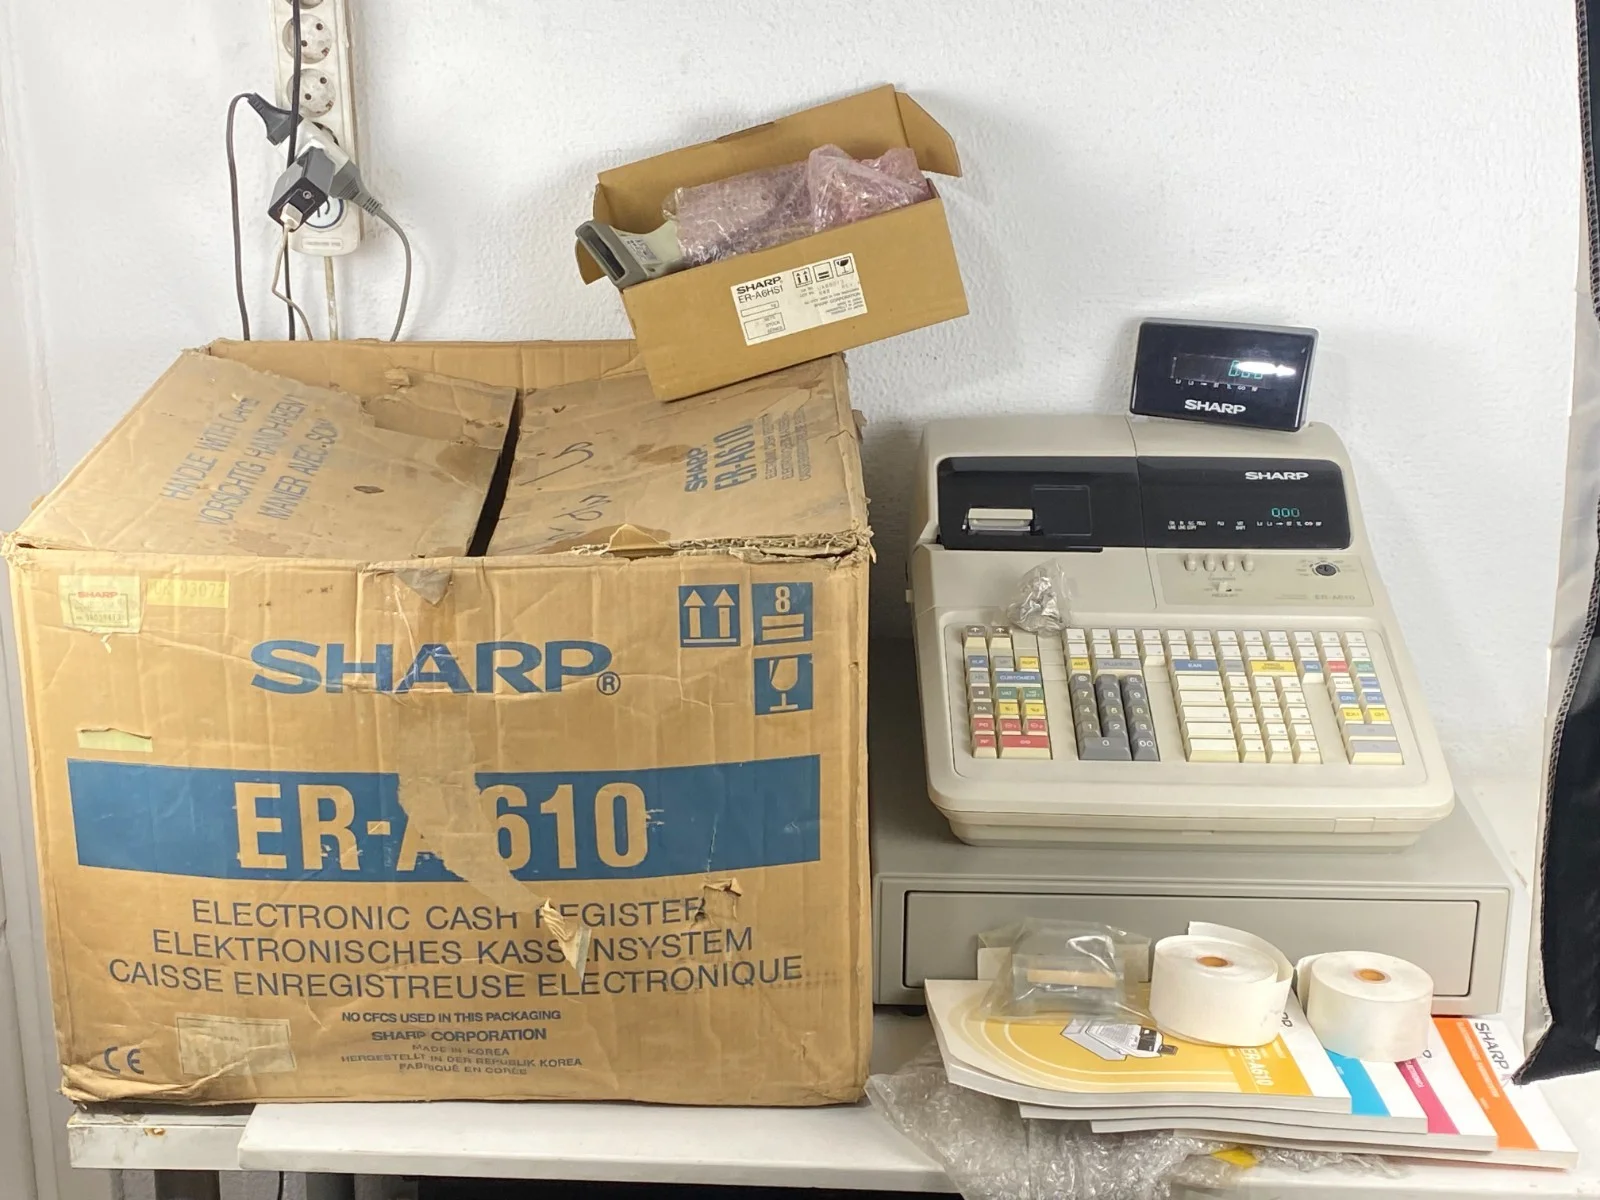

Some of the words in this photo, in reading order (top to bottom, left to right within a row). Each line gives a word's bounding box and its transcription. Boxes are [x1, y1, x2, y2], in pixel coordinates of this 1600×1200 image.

[736, 276, 782, 295] SHARP
[738, 285, 784, 304] ER-A6HS1
[1185, 399, 1246, 415] SHARP
[684, 446, 708, 493] SHARP
[714, 419, 757, 491] ER-A610
[159, 452, 218, 501] HANDLE
[1245, 471, 1309, 480] SHARP
[195, 459, 267, 526] VORSICHTIG
[775, 586, 791, 613] 8
[251, 639, 613, 694] SHARP
[192, 898, 410, 930] ELECTRONIC
[426, 905, 517, 930] CASH
[153, 929, 462, 965] ELEKTRONISCHES
[478, 927, 752, 964] KASSNSYSTEM
[109, 958, 223, 993] CAISSE
[234, 971, 525, 999] ENREGISTREUSE
[538, 955, 803, 997] ELECTRONIQUE
[342, 1012, 360, 1022] NO
[363, 1012, 397, 1023] CFCS
[401, 1012, 436, 1023] USED
[438, 1013, 451, 1023] IN
[454, 1012, 483, 1023] THIS
[486, 1010, 562, 1022] PACKAGING
[371, 1030, 426, 1041] SHARP
[431, 1028, 547, 1042] CORPORATION
[412, 1044, 446, 1053] MADE
[468, 1047, 510, 1056] KOREA
[1474, 1021, 1510, 1071] SHARP
[104, 1046, 144, 1075] CE
[341, 1052, 425, 1062] HERGESTELLT
[447, 1056, 472, 1064] DER
[476, 1057, 536, 1067] REPUBLIK
[540, 1058, 583, 1068] KOREA
[1239, 1047, 1275, 1087] ER-A610
